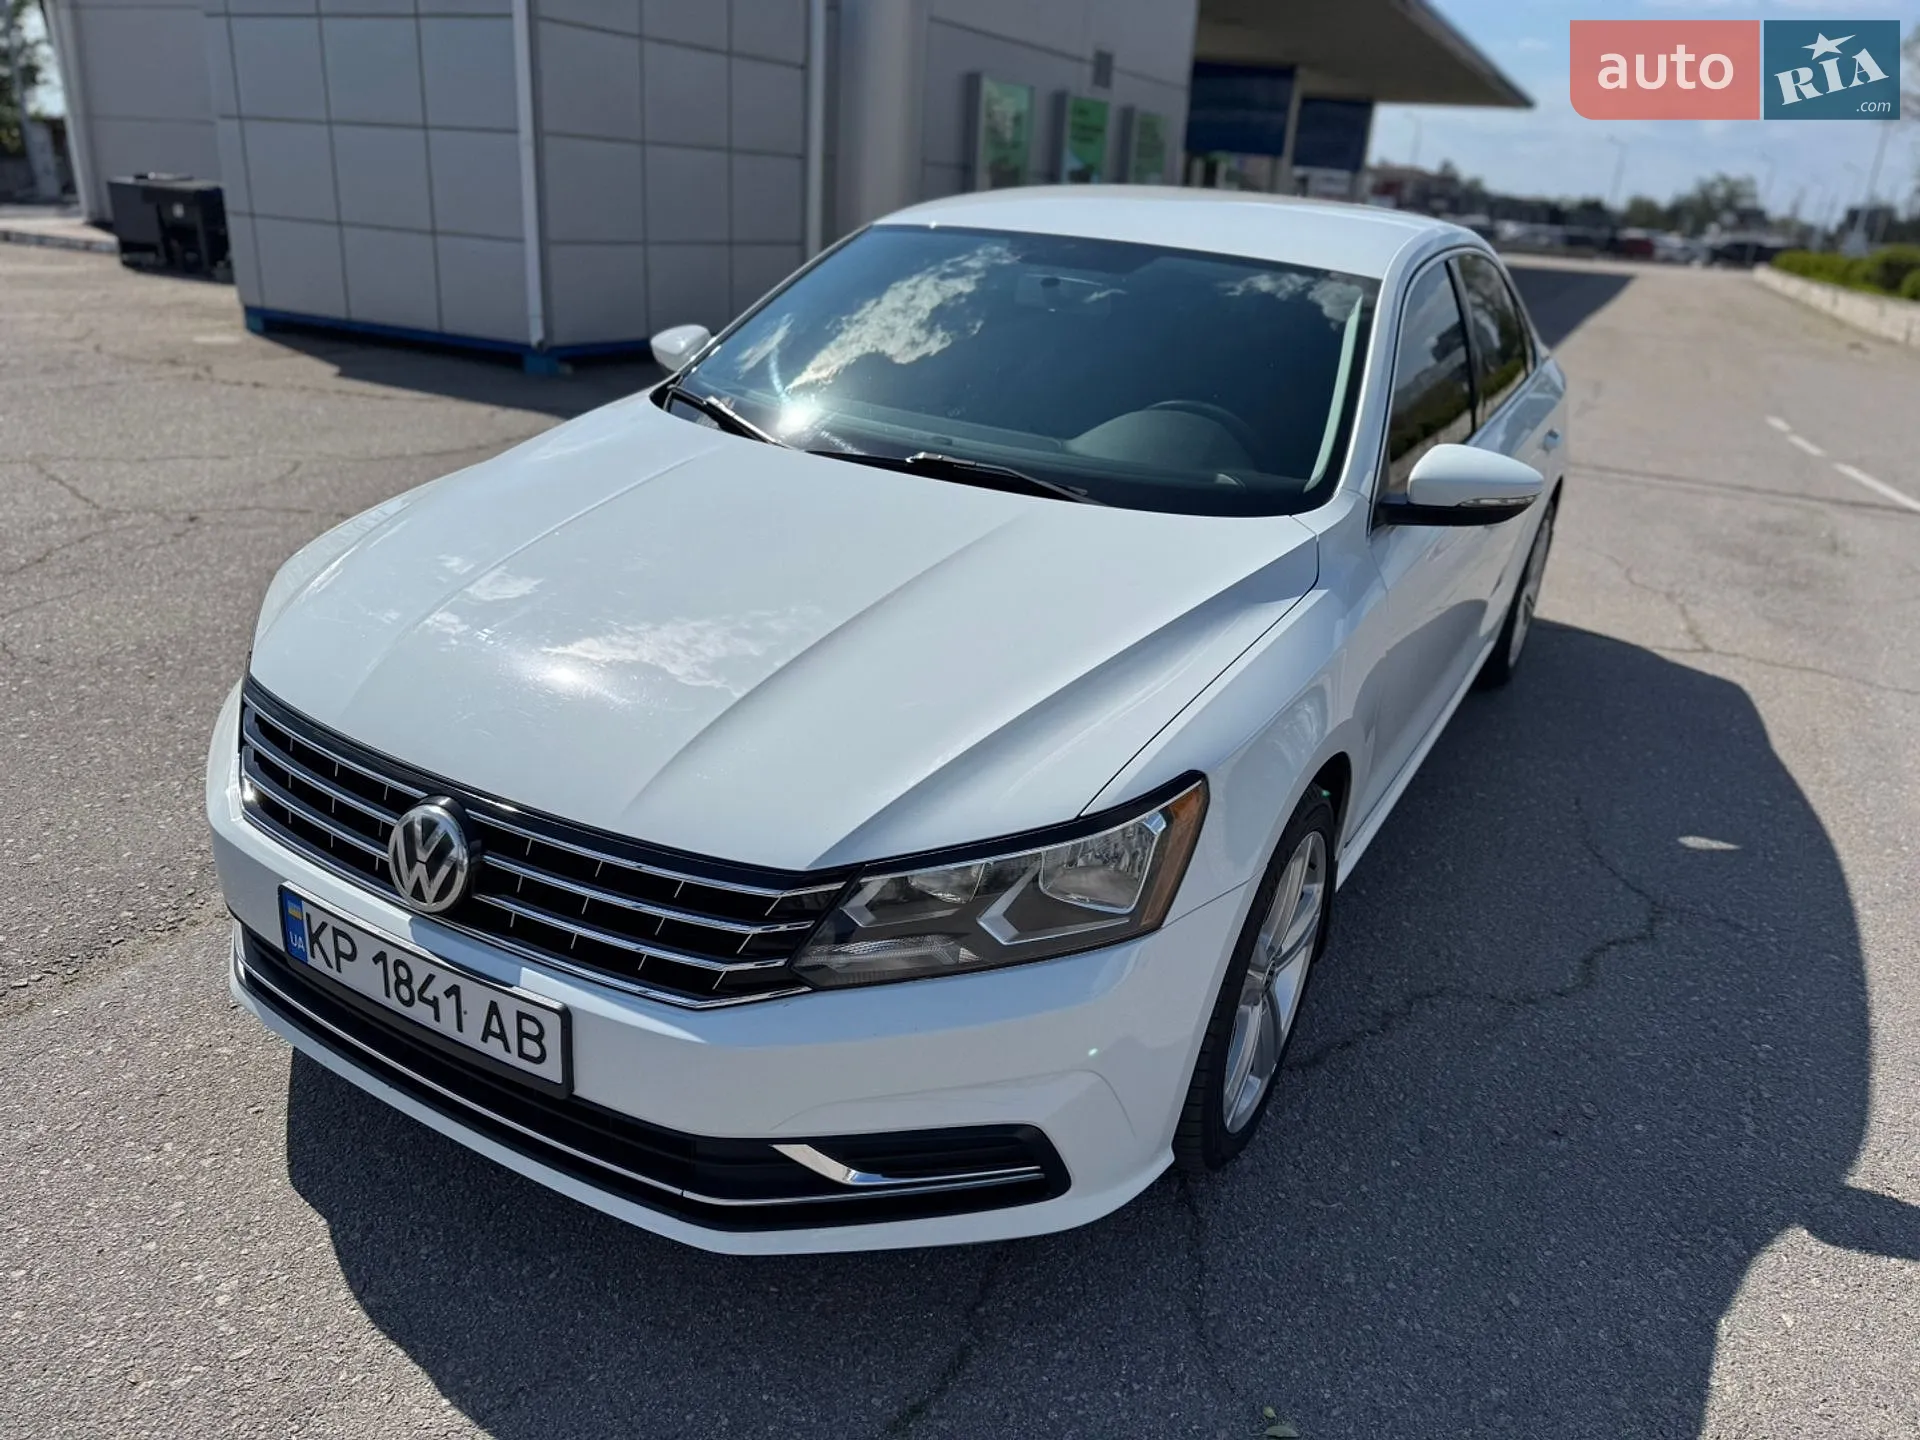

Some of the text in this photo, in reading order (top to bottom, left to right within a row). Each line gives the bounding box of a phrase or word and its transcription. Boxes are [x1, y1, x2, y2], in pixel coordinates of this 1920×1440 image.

[289, 931, 305, 952] UA
[306, 912, 547, 1065] KP 1841 AB
